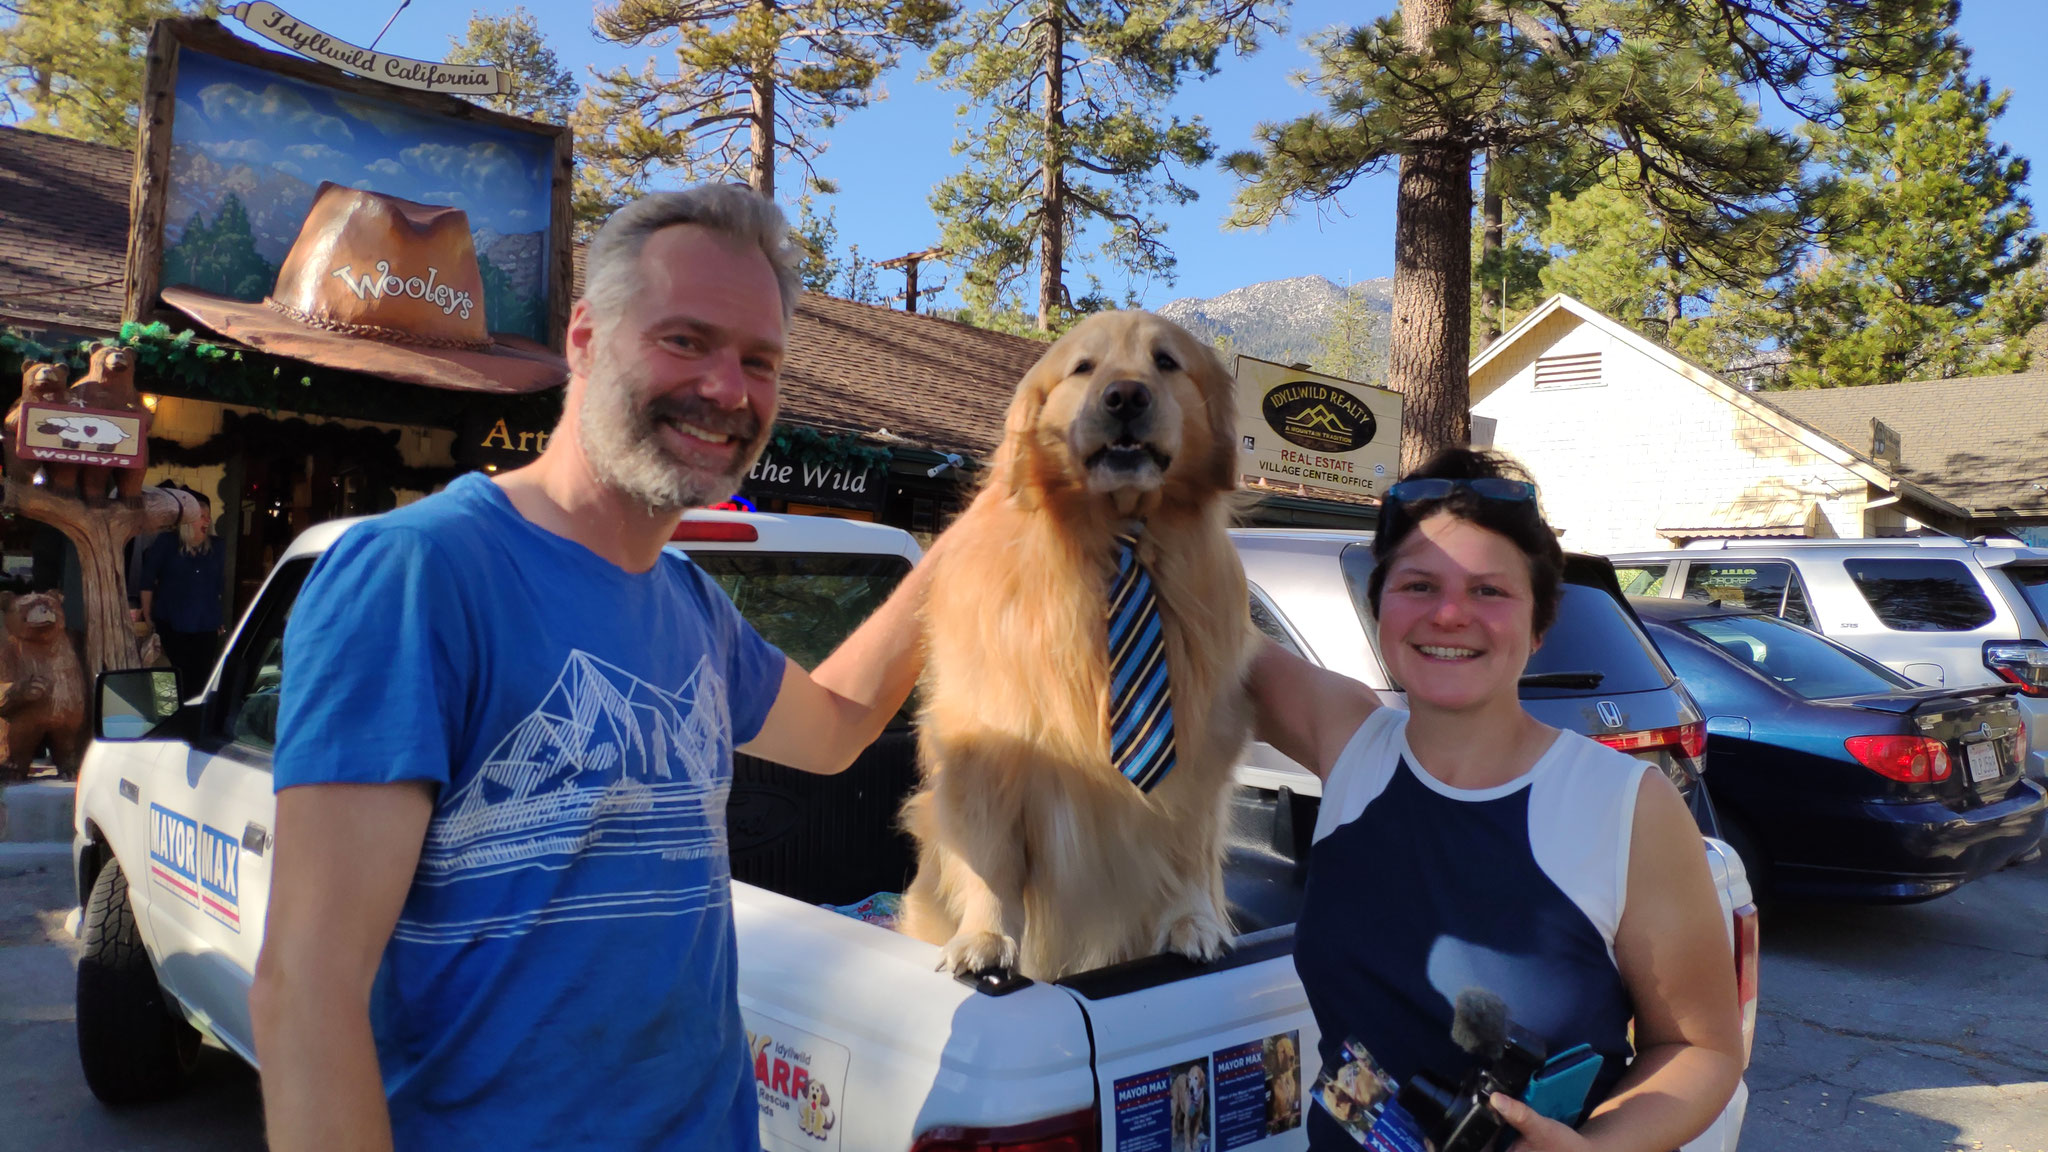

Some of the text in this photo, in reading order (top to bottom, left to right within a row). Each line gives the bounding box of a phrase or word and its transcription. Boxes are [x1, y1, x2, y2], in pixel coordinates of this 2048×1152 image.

[263, 10, 489, 88] Idyllwild California
[331, 259, 474, 320] Wooley's
[1270, 386, 1370, 424] IDYLLWILD REALTY
[1291, 426, 1322, 437] MOUNTAIN
[1322, 432, 1353, 444] TRADITION
[32, 449, 130, 465] Wooley's
[1280, 449, 1354, 473] REAL ESTATE
[749, 453, 868, 493] the Wild
[1259, 460, 1373, 489] VILLAGE CENTER OFFICE
[150, 808, 238, 897] MAYOR MAX
[775, 1042, 811, 1065] Idyllwild
[1218, 1052, 1262, 1073] MAYOR MAX
[755, 1052, 809, 1100] ARF
[759, 1088, 790, 1110] Rescue
[1118, 1080, 1167, 1102] MAYOR MAX
